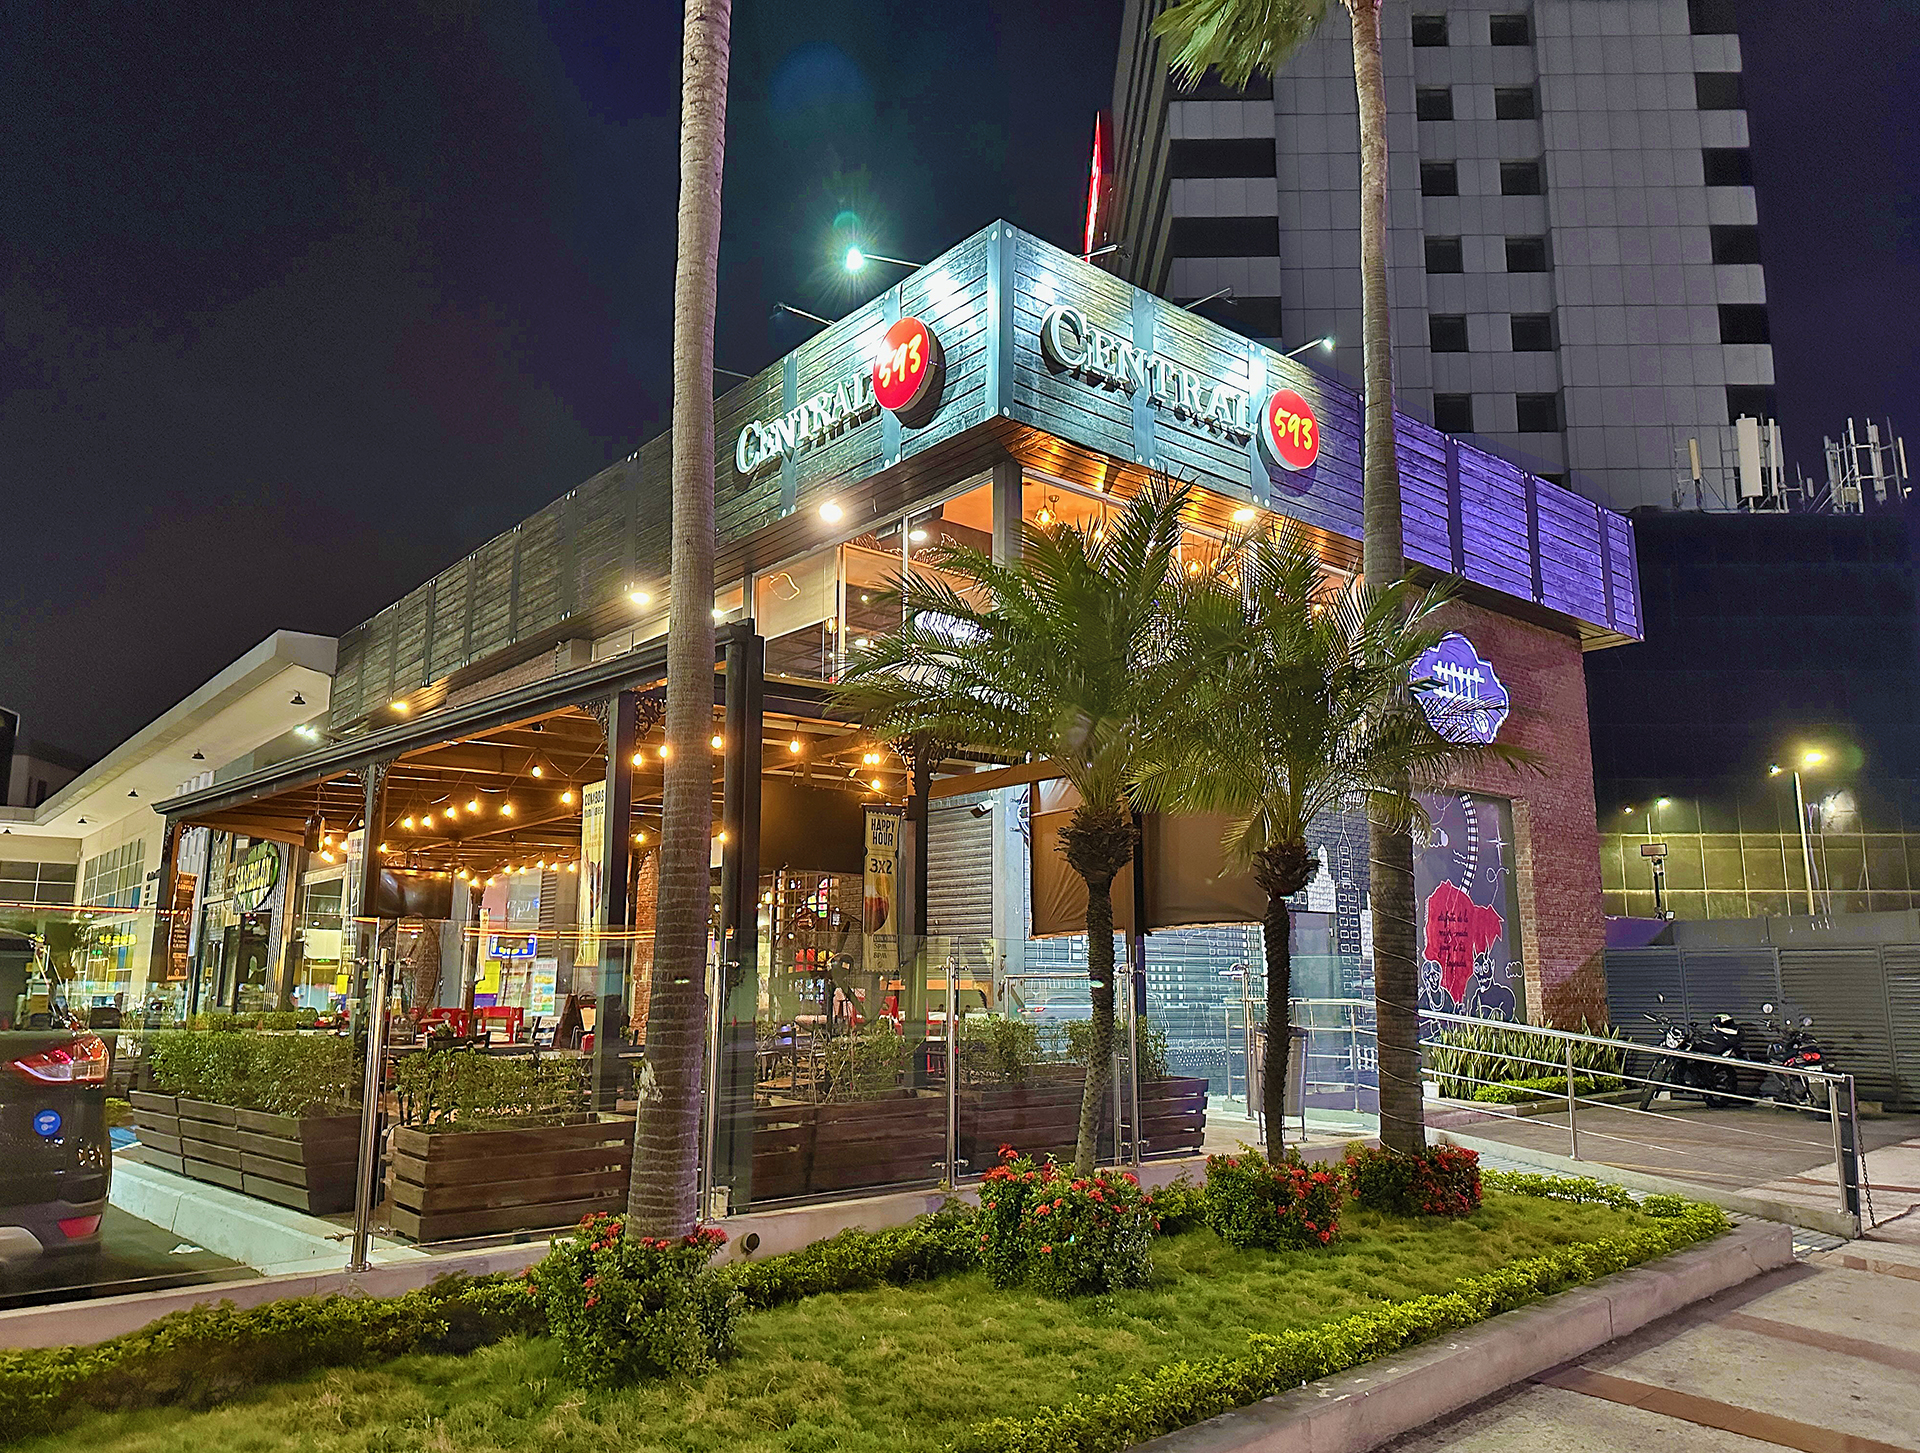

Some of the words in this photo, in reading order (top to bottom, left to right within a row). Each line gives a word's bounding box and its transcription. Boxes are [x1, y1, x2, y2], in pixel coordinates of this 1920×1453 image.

[878, 333, 922, 388] 593
[1039, 303, 1258, 438] CENTRAL
[735, 371, 878, 474] CENTRAL
[1273, 407, 1313, 450] 593
[871, 818, 895, 833] HAPPY
[872, 831, 894, 847] HOUR
[869, 858, 892, 874] 3X2
